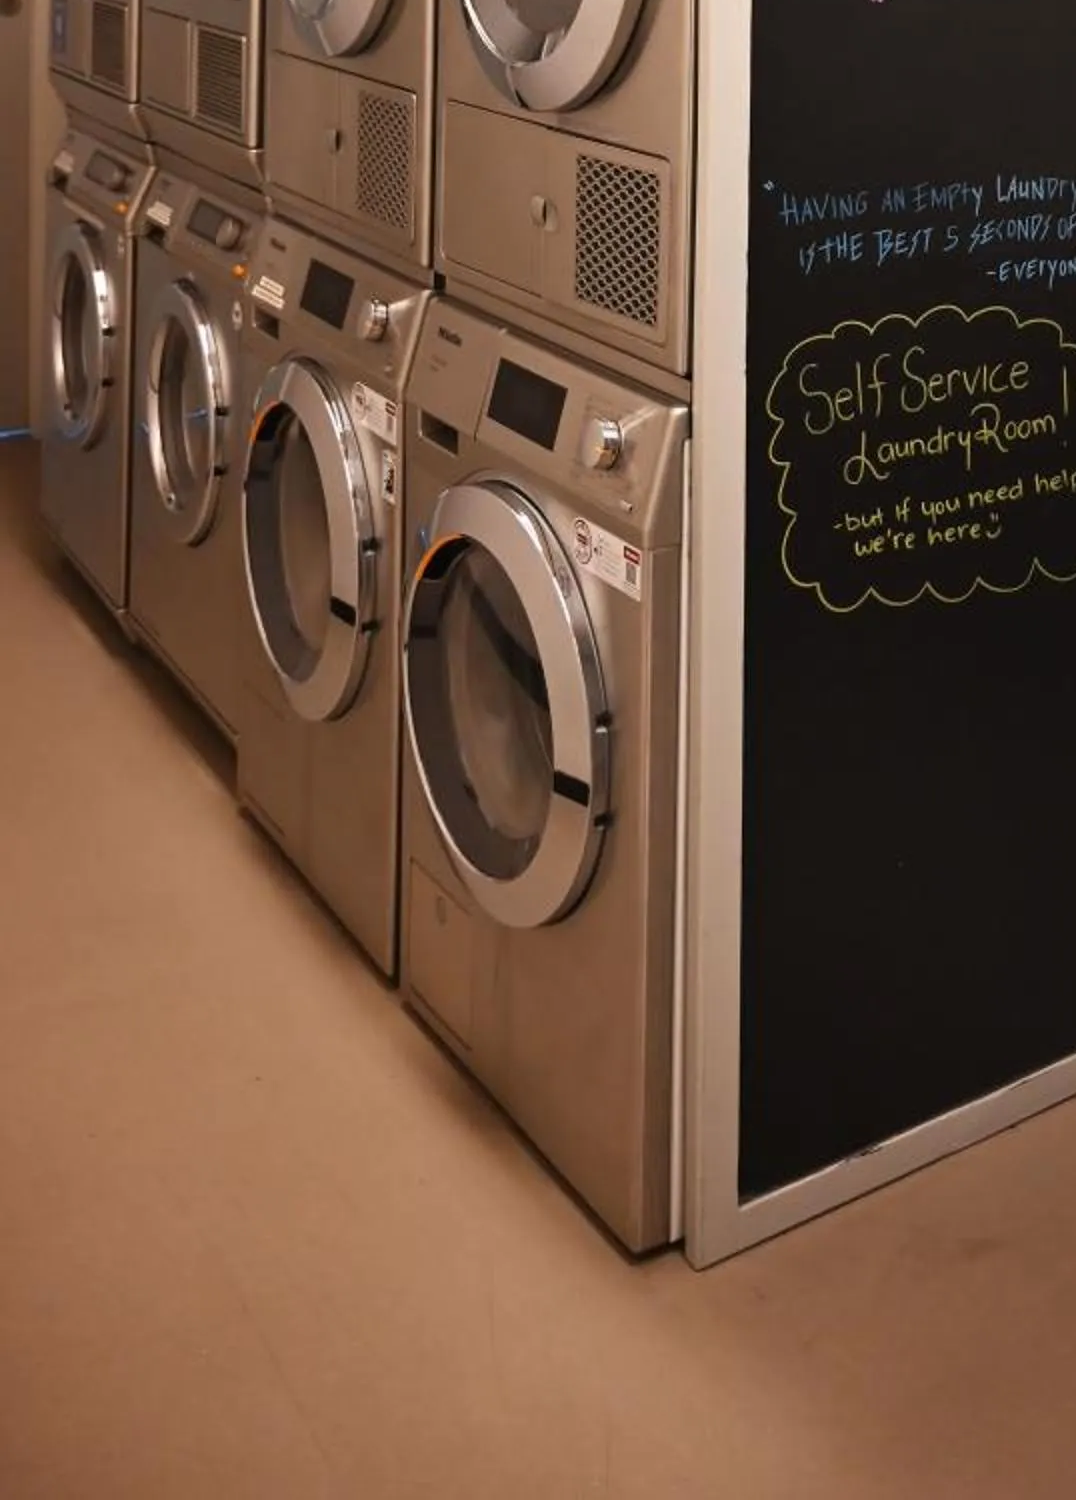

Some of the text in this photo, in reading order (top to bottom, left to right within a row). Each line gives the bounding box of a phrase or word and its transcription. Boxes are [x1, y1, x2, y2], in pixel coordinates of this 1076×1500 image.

[880, 187, 907, 213] AN
[872, 227, 935, 267] BEST
[943, 225, 963, 252] 5
[968, 212, 1052, 254] SECONDS
[799, 345, 1029, 435] Self Service
[843, 425, 972, 485] Laundry
[921, 497, 961, 526] you
[968, 479, 1024, 510] need
[854, 524, 982, 557] we're here
